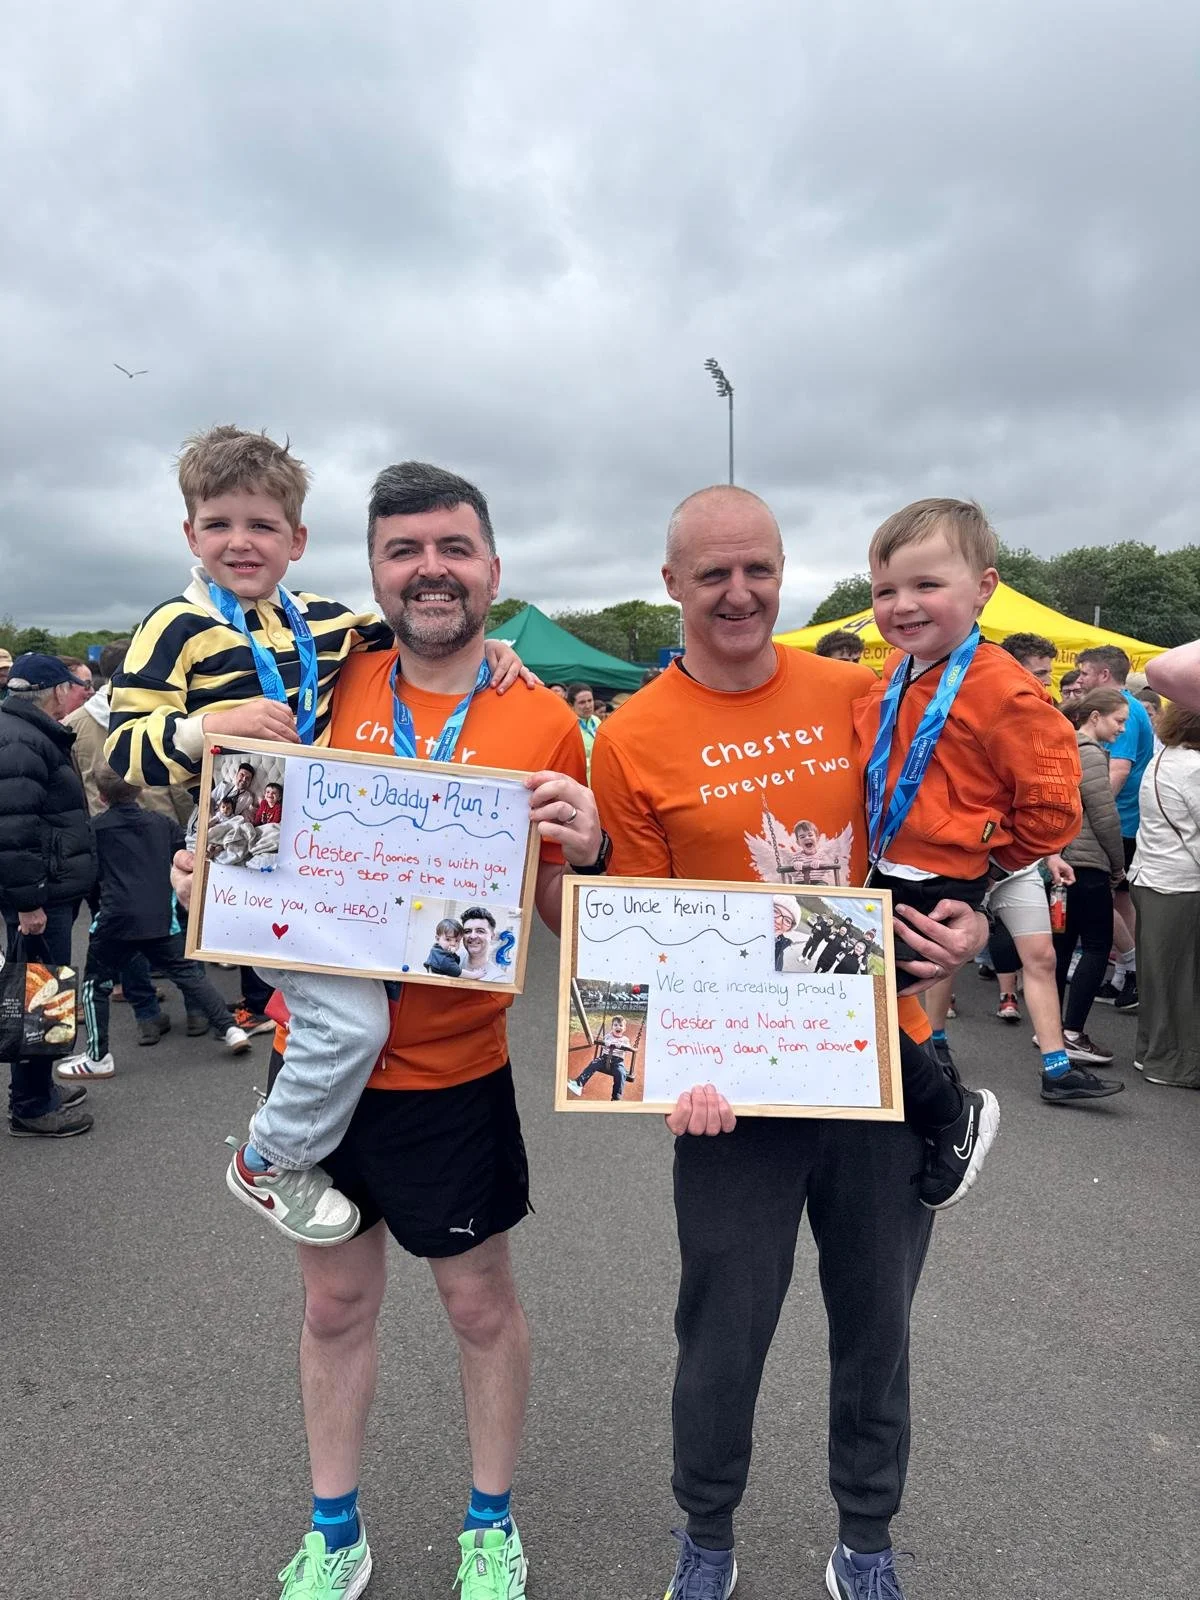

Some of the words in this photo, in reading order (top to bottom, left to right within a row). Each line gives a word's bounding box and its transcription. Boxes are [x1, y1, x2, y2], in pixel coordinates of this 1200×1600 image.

[355, 720, 476, 764] Chtr
[701, 725, 824, 767] Chester
[307, 764, 352, 807] Run
[371, 775, 429, 827] Daddy
[700, 769, 795, 804] Forever
[801, 757, 849, 775] Two
[299, 865, 344, 886] every
[358, 868, 388, 883] step
[398, 870, 415, 883] of
[420, 872, 445, 885] the
[454, 879, 487, 897] way!
[428, 855, 442, 868] is
[449, 855, 479, 871] with
[485, 864, 507, 884] you
[213, 884, 236, 906] We
[245, 892, 273, 909] love
[282, 898, 307, 917] you,
[344, 902, 387, 924] HERO!
[586, 890, 614, 919] Go
[624, 893, 662, 915] Uncle
[656, 970, 684, 993] We
[694, 979, 719, 993] are
[727, 974, 789, 1006] incredibly
[661, 1009, 715, 1030] Chester
[726, 1016, 749, 1030] and
[758, 1010, 796, 1030] Noah
[803, 1017, 831, 1030] are
[667, 1039, 723, 1064] Smiling
[734, 1041, 768, 1054] down
[778, 1038, 808, 1052] from
[816, 1040, 855, 1053] above
